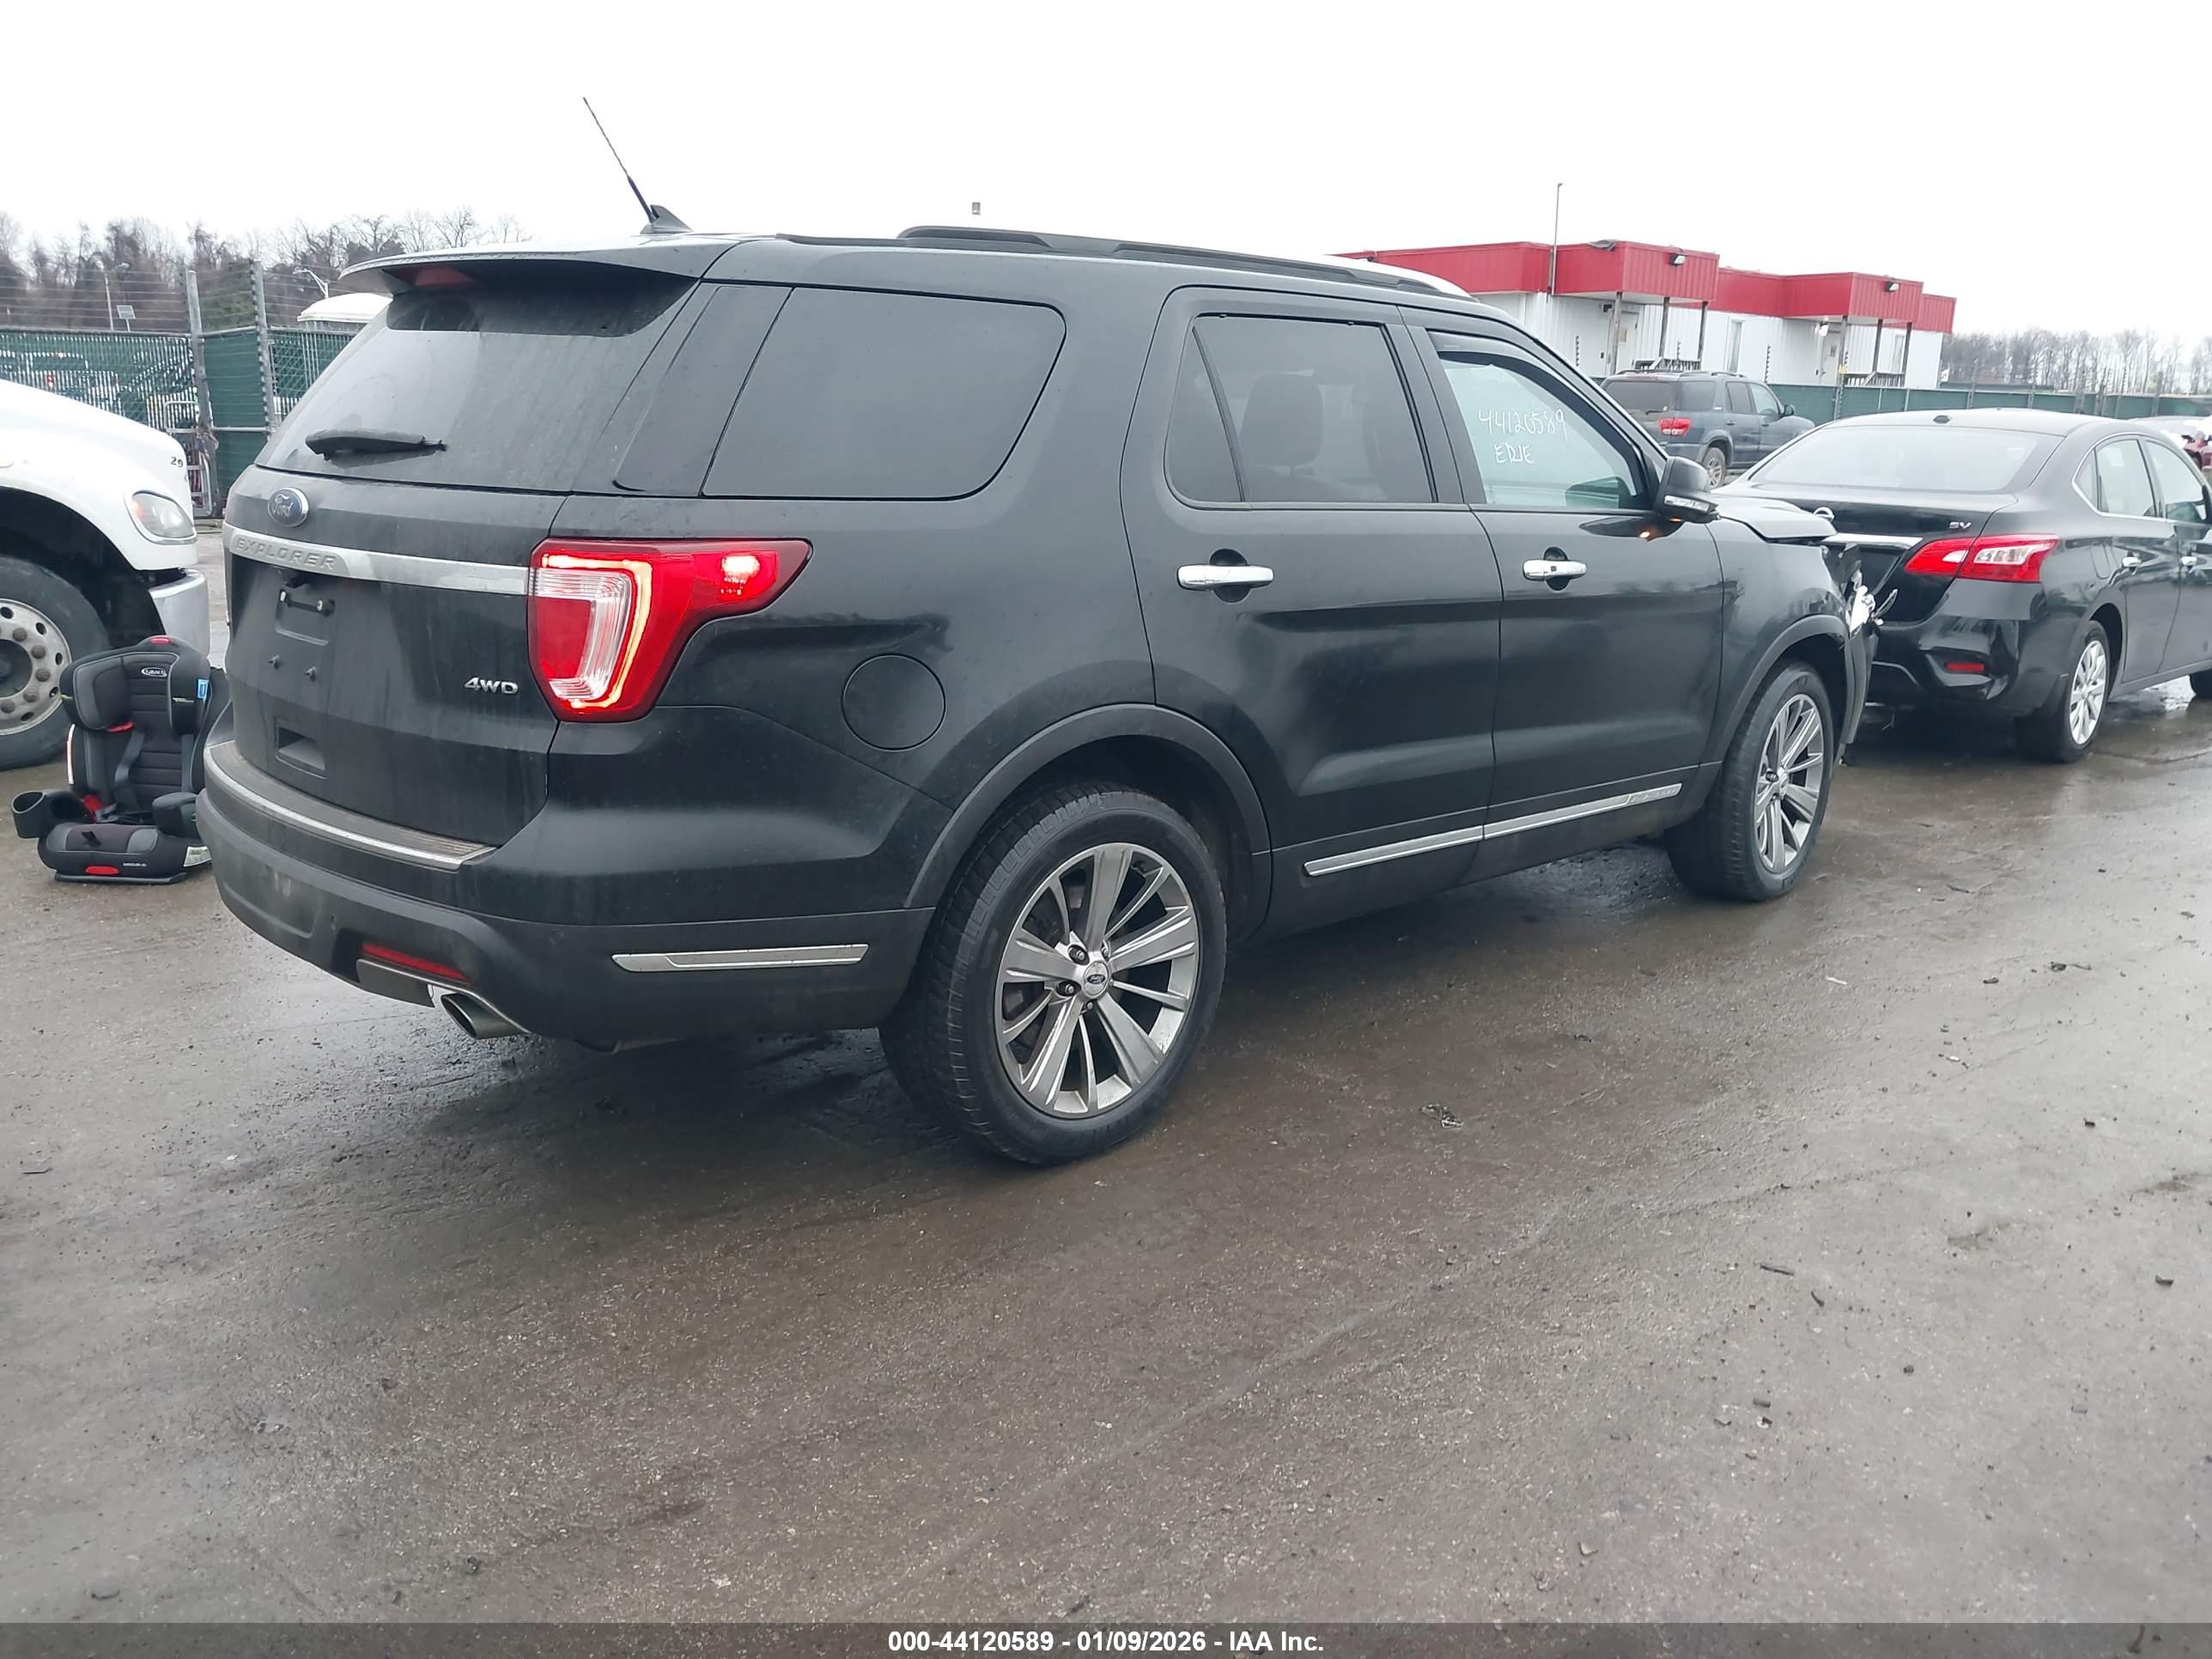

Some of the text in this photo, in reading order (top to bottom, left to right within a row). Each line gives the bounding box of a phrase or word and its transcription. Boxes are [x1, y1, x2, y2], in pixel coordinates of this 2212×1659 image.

[1478, 408, 1567, 440] 44120589
[271, 493, 294, 517] Ford
[234, 537, 337, 570] EXPLORER
[464, 677, 519, 695] 4WD
